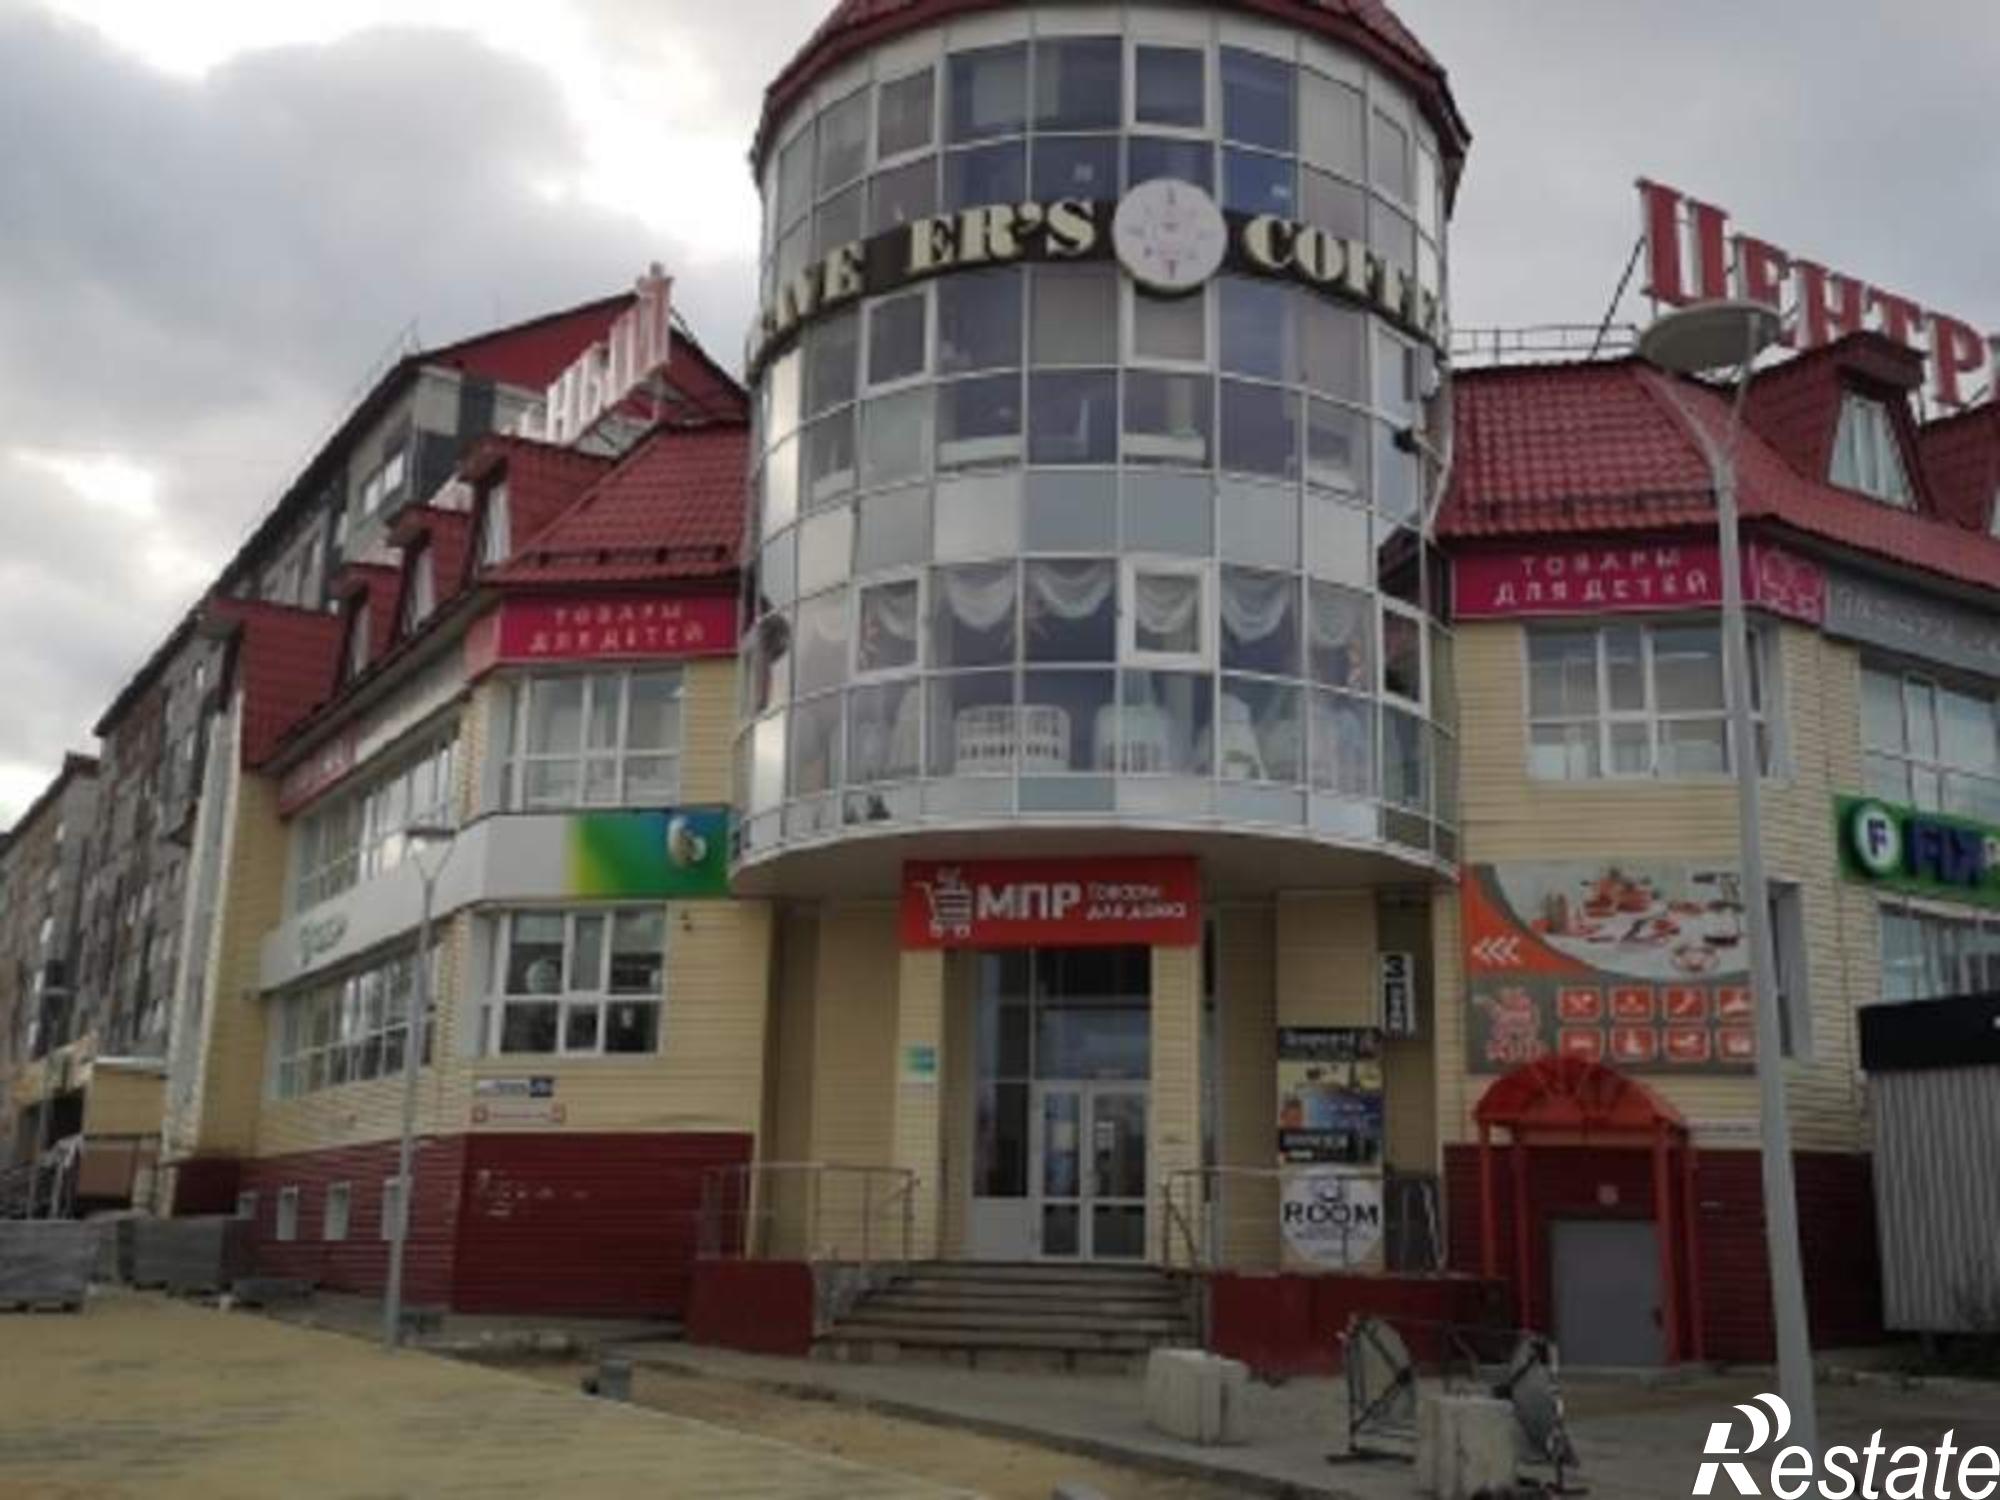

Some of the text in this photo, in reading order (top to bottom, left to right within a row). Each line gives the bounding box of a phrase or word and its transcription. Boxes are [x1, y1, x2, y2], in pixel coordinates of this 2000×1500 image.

[1519, 548, 1682, 577] ТОВАРЫ
[1494, 569, 1710, 607] ДЛЯ ДЕТЕЙ
[977, 882, 1082, 921] МПР
[1284, 1202, 1380, 1225] ROOM
